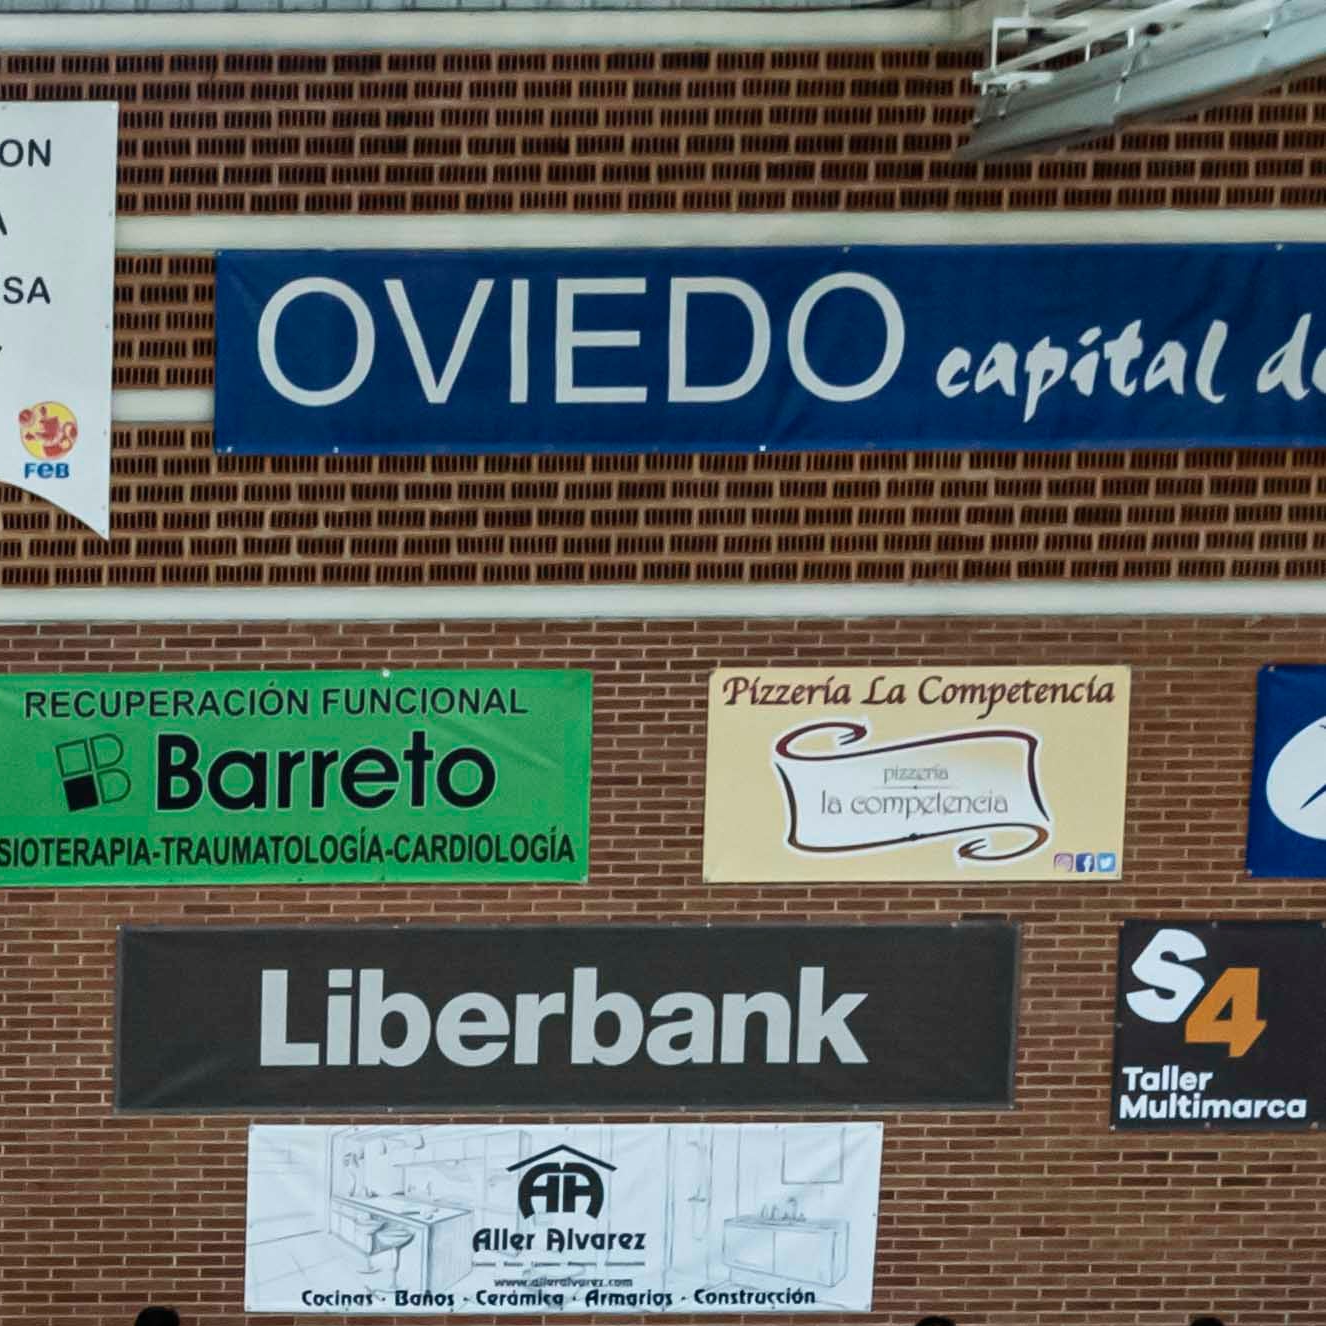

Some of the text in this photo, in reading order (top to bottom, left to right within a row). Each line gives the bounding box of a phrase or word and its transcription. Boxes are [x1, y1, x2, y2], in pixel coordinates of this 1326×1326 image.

[258, 272, 906, 406] OVIEDO
[936, 318, 1228, 423] capital
[24, 681, 528, 719] RECUPERACIÓN FUNCIONAL
[860, 676, 906, 705] La
[156, 729, 497, 811] Barreto
[821, 790, 1009, 818] la competencia
[1126, 928, 1267, 1057] S4
[259, 966, 870, 1068] Liberbank
[1122, 1065, 1214, 1091] Taller
[1119, 1093, 1307, 1119] Multimarca
[472, 1228, 646, 1254] Aller Alvarez
[301, 1286, 816, 1309] Cocinas Baños Cerámica Armarios Construcción
